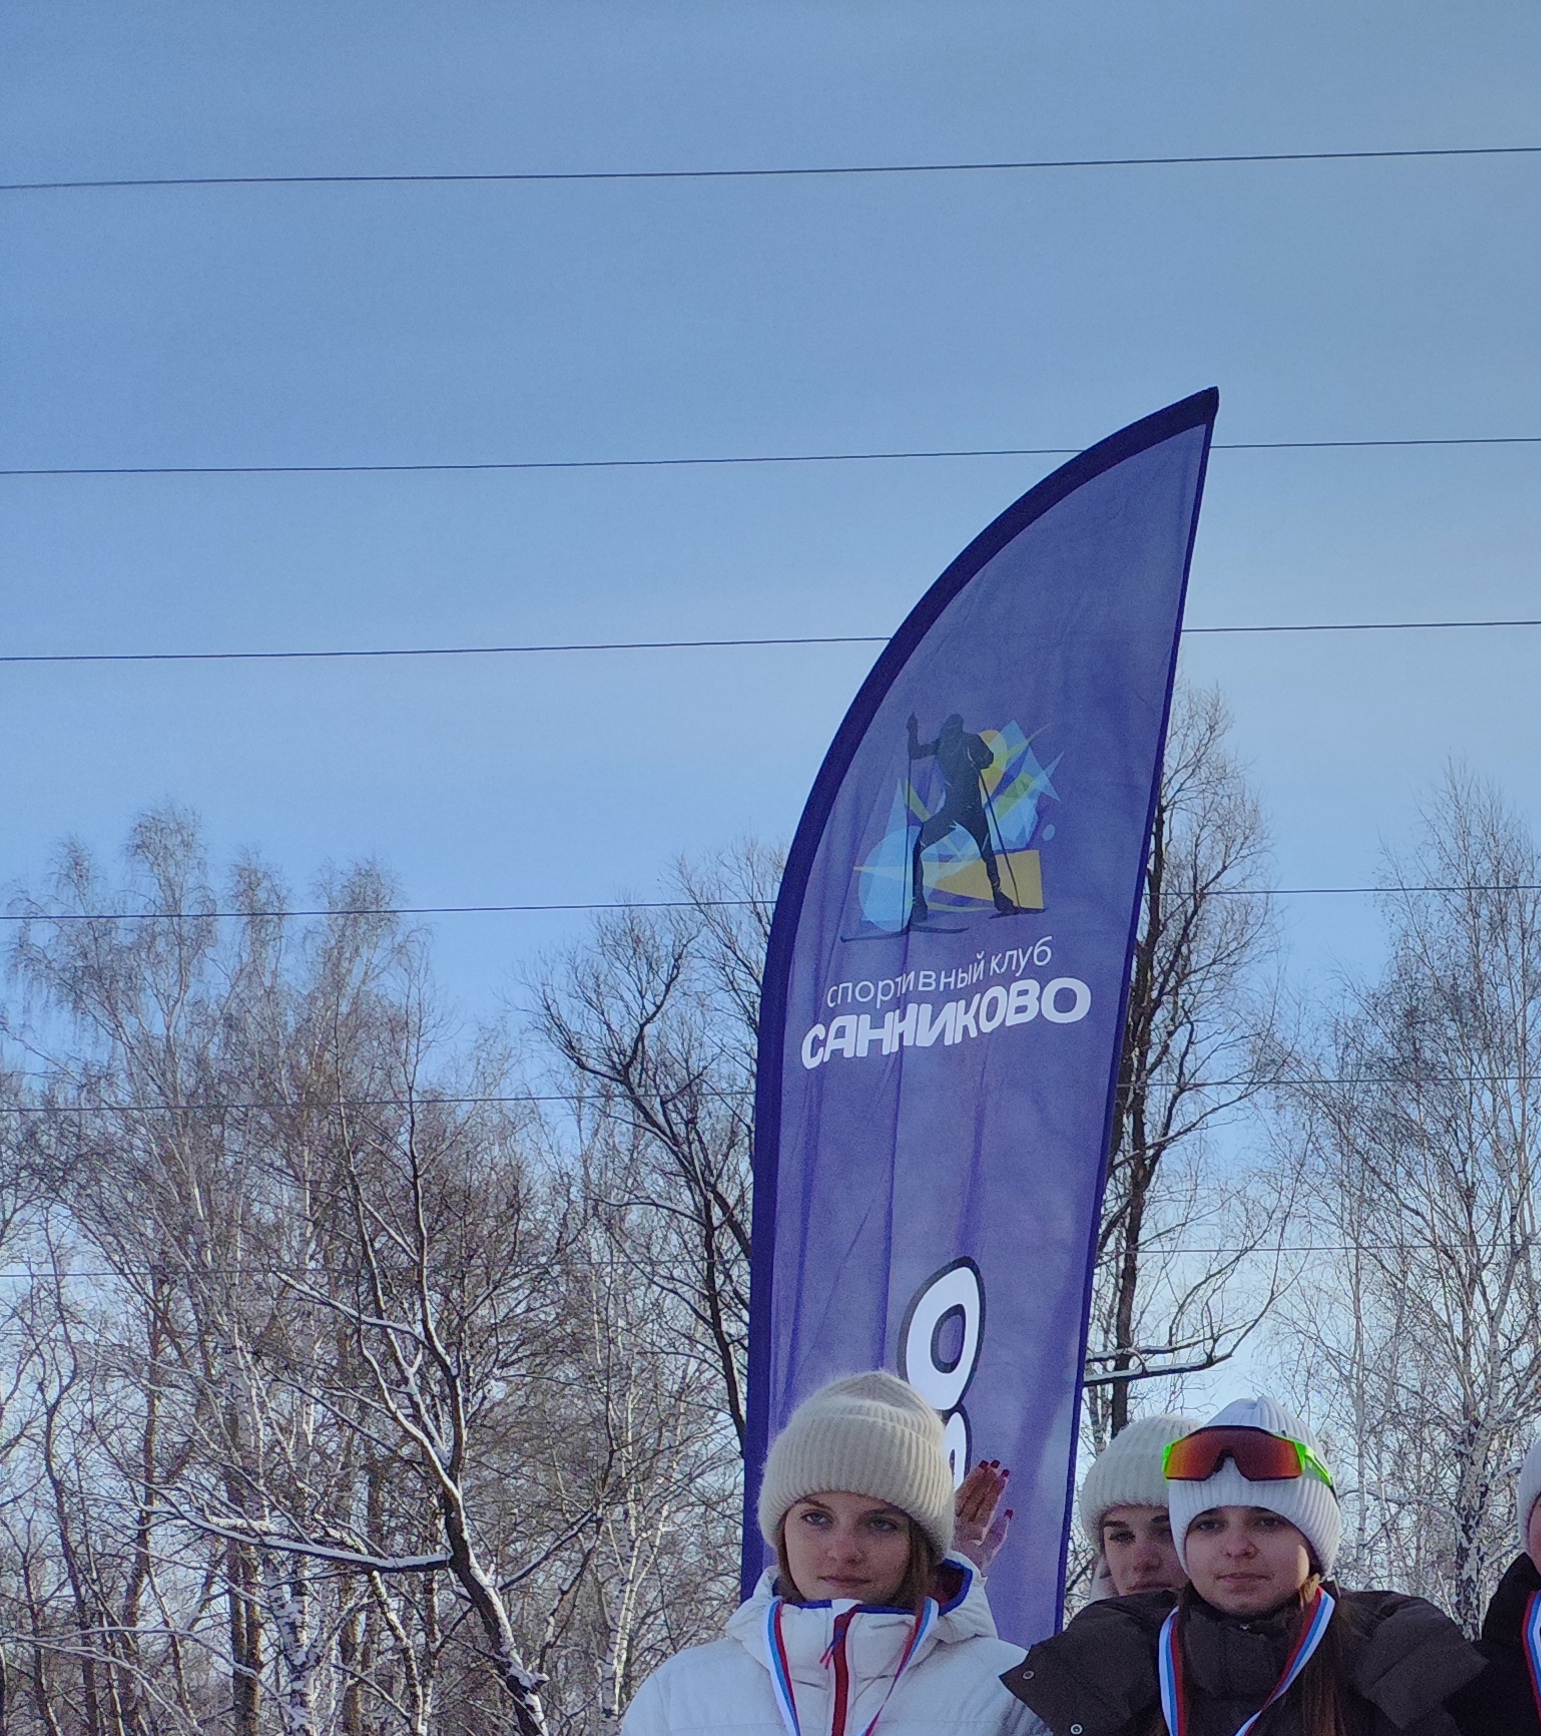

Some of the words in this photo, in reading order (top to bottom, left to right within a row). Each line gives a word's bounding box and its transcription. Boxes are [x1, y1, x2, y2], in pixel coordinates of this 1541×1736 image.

[826, 956, 985, 1008] спортивный
[988, 936, 1053, 977] клуб
[801, 977, 1092, 1069] САННИКОВО
